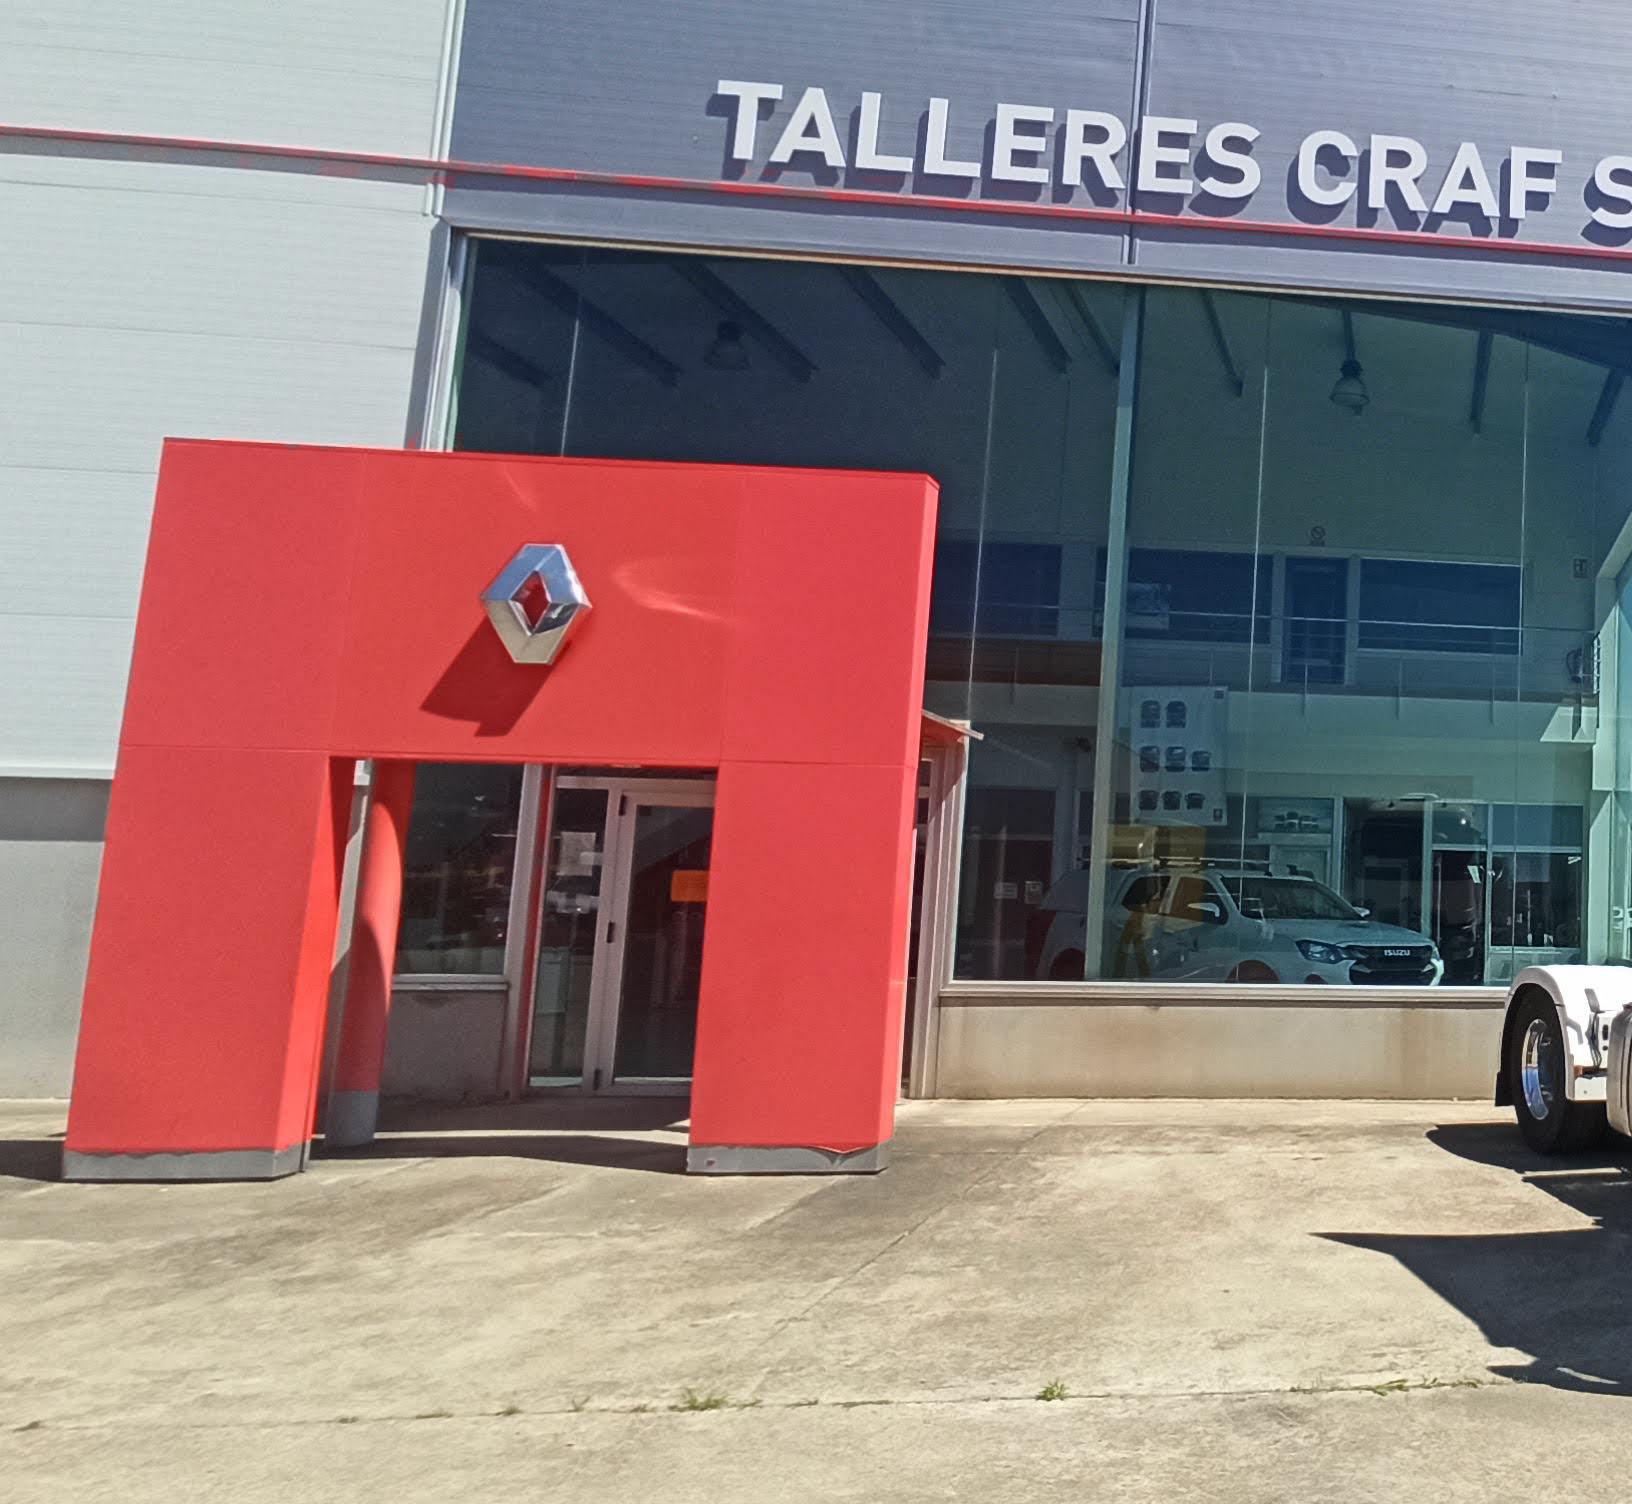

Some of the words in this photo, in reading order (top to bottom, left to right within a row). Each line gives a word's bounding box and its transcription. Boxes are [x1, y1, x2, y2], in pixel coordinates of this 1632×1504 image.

[717, 80, 1262, 199] TALLERES
[1298, 130, 1564, 220] CRAF
[1383, 949, 1411, 957] ISUZU
